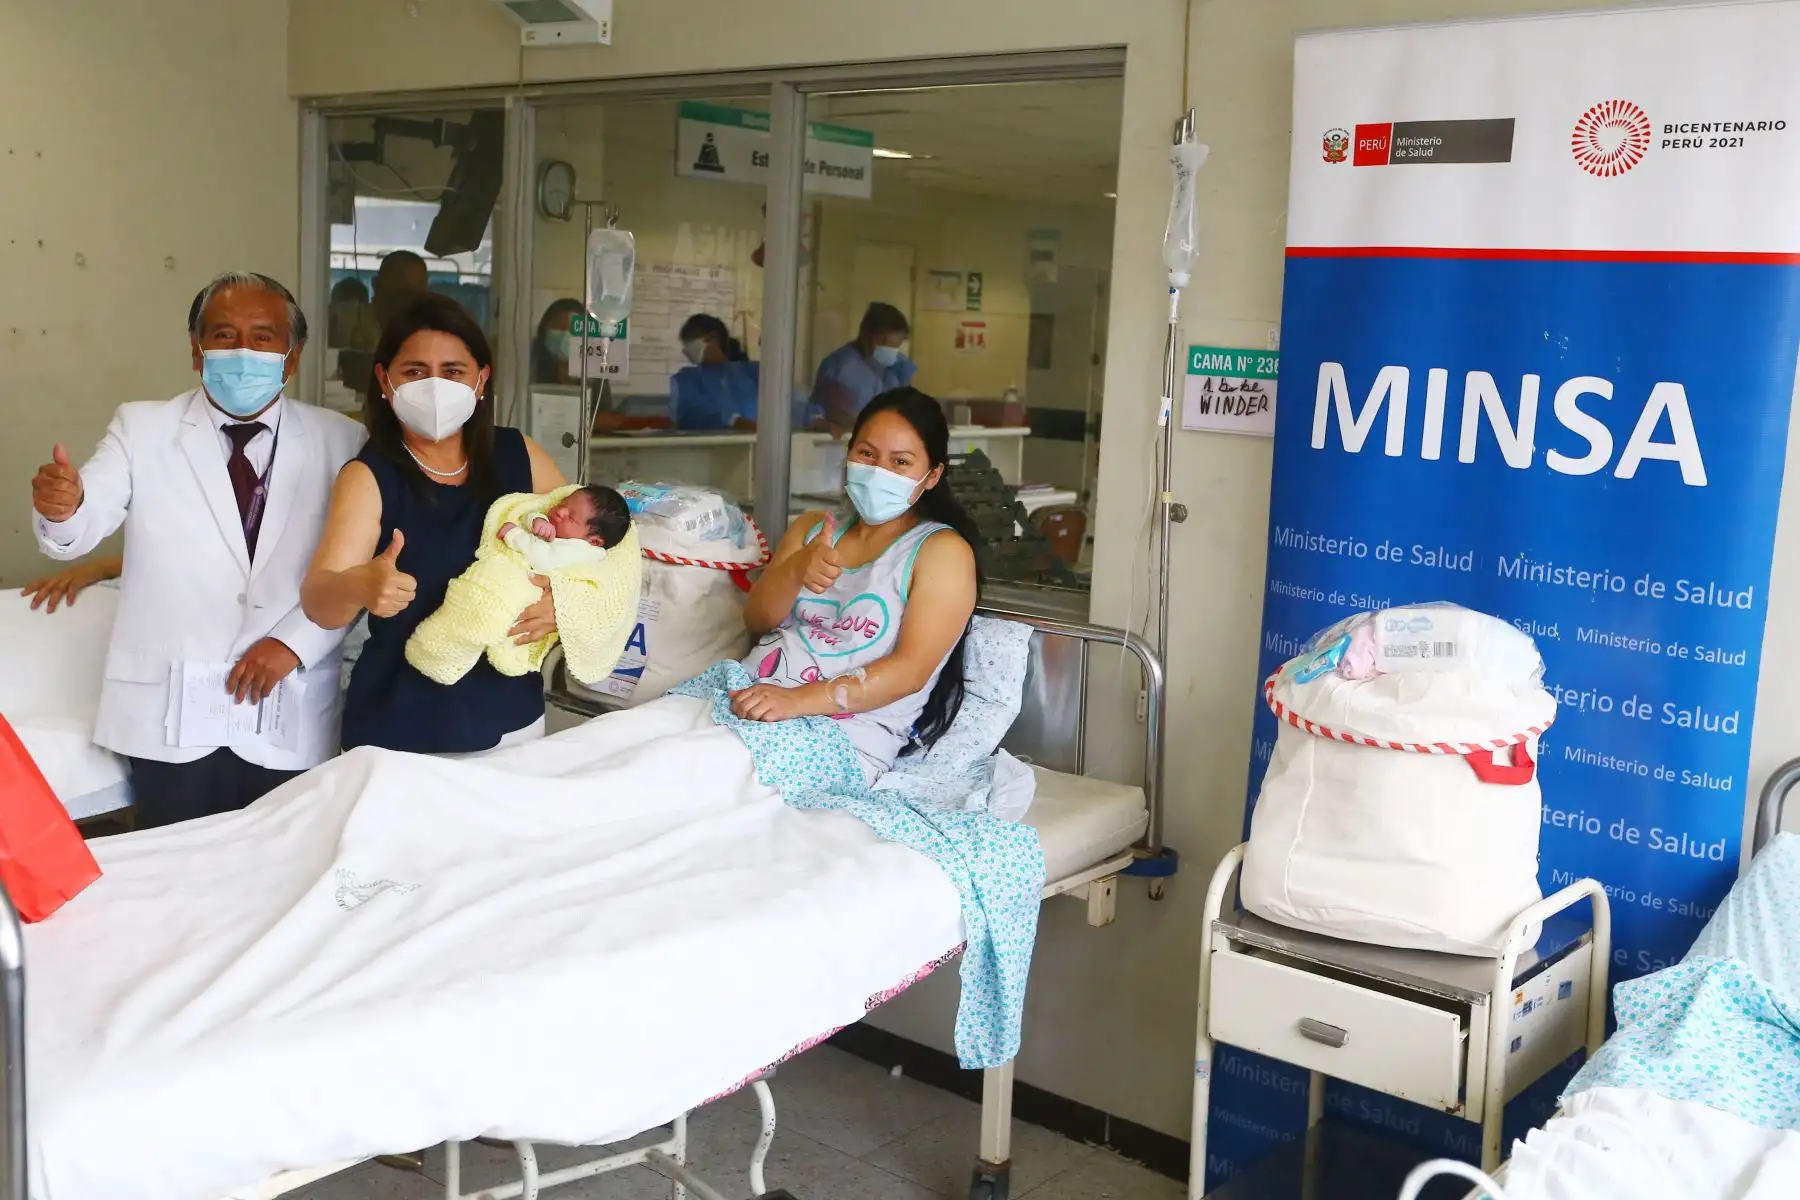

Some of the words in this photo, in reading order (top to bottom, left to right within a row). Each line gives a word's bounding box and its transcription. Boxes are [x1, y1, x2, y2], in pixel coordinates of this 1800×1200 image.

[1663, 120, 1787, 134] BICENTENARIO
[1359, 136, 1387, 151] PERÚ
[1395, 149, 1407, 157] de
[1408, 147, 1434, 157] Salud
[1396, 136, 1443, 147] Ministerio
[1661, 135, 1703, 149] PERÚ
[1709, 137, 1744, 148] 2021
[818, 160, 865, 181] Personal
[1193, 352, 1233, 371] CAMA
[1237, 355, 1253, 372] N°
[1200, 394, 1269, 416] WINDER
[1311, 361, 1708, 487] MINSA
[1274, 525, 1368, 559] Ministerio
[1375, 540, 1403, 563] de
[1410, 544, 1474, 572] Salud
[1270, 579, 1325, 602] Ministerio
[1328, 590, 1346, 606] de
[1497, 556, 1626, 593] Ministerio
[1634, 573, 1666, 599] de
[1674, 579, 1754, 610] Salud
[832, 615, 880, 638] LOVE
[1576, 627, 1661, 654] Ministerio
[1666, 642, 1689, 658] de
[1694, 646, 1746, 666] Salud
[1621, 695, 1653, 721] de
[1661, 703, 1740, 734] Salud
[1564, 746, 1649, 777] Ministerio
[1653, 765, 1676, 782] de
[1680, 770, 1733, 792] Salud
[1609, 818, 1640, 845] de
[1648, 828, 1726, 861] Salud
[1641, 892, 1663, 910] de
[1219, 1049, 1310, 1097] Ministeri
[1358, 1098, 1420, 1135] Salud
